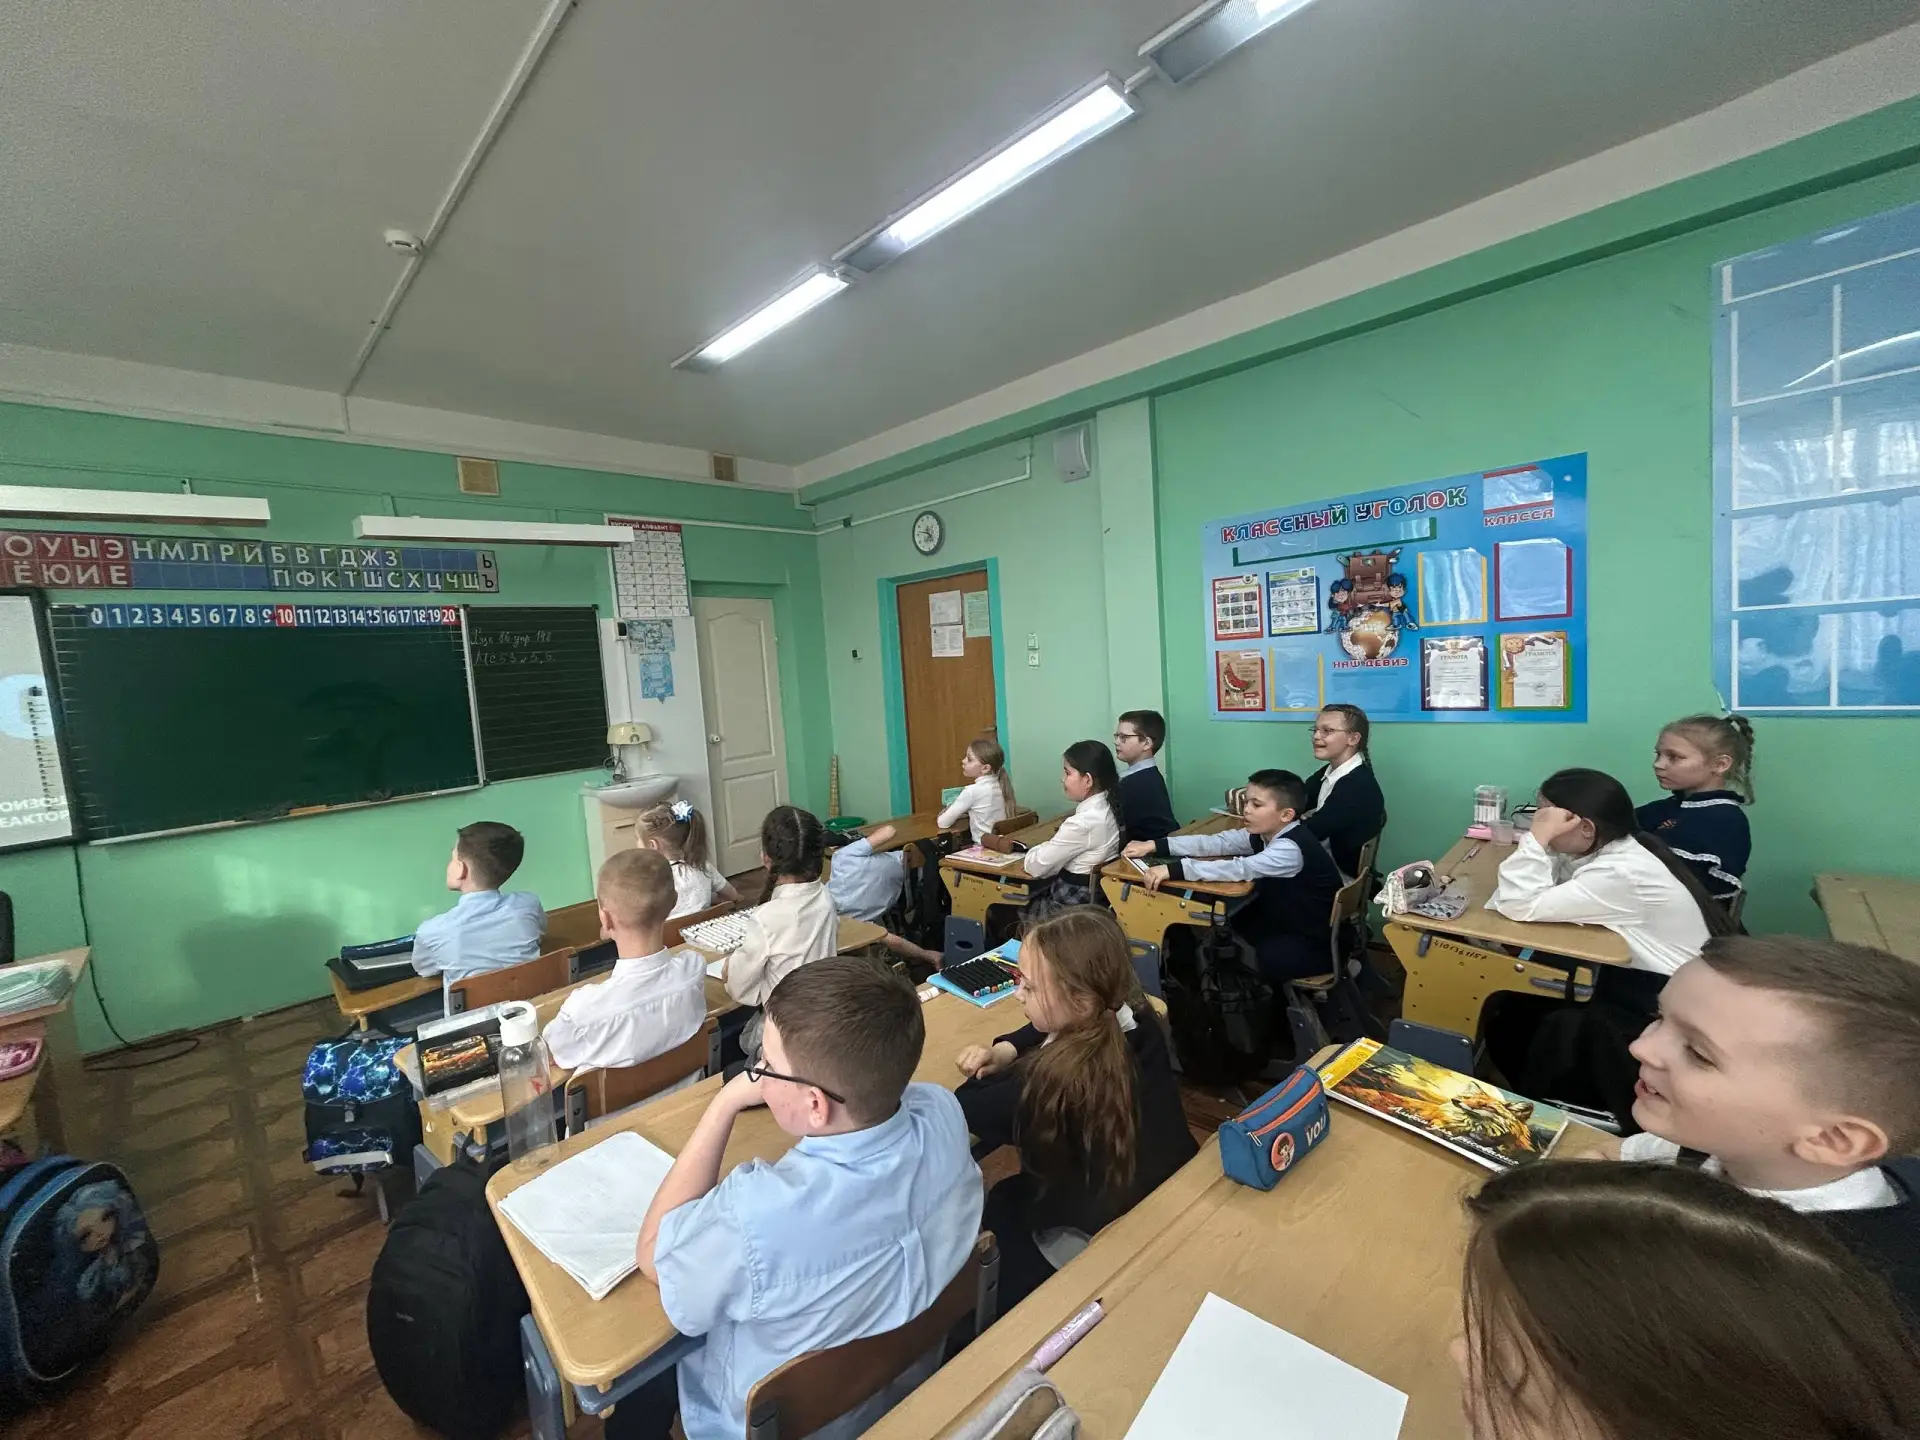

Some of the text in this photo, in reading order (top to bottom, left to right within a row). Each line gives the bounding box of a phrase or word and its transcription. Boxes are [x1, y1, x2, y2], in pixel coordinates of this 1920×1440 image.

[1221, 485, 1468, 544] КЛАССНЫЙ УГОЛОК
[1483, 507, 1555, 527] КЛАССА
[90, 608, 456, 625] 0 1 2 3 4 5 6 7 8 9 10 11 12 13 14 15 16 17 18 19 20
[1333, 658, 1409, 669] НАШ ДЕВИЗ
